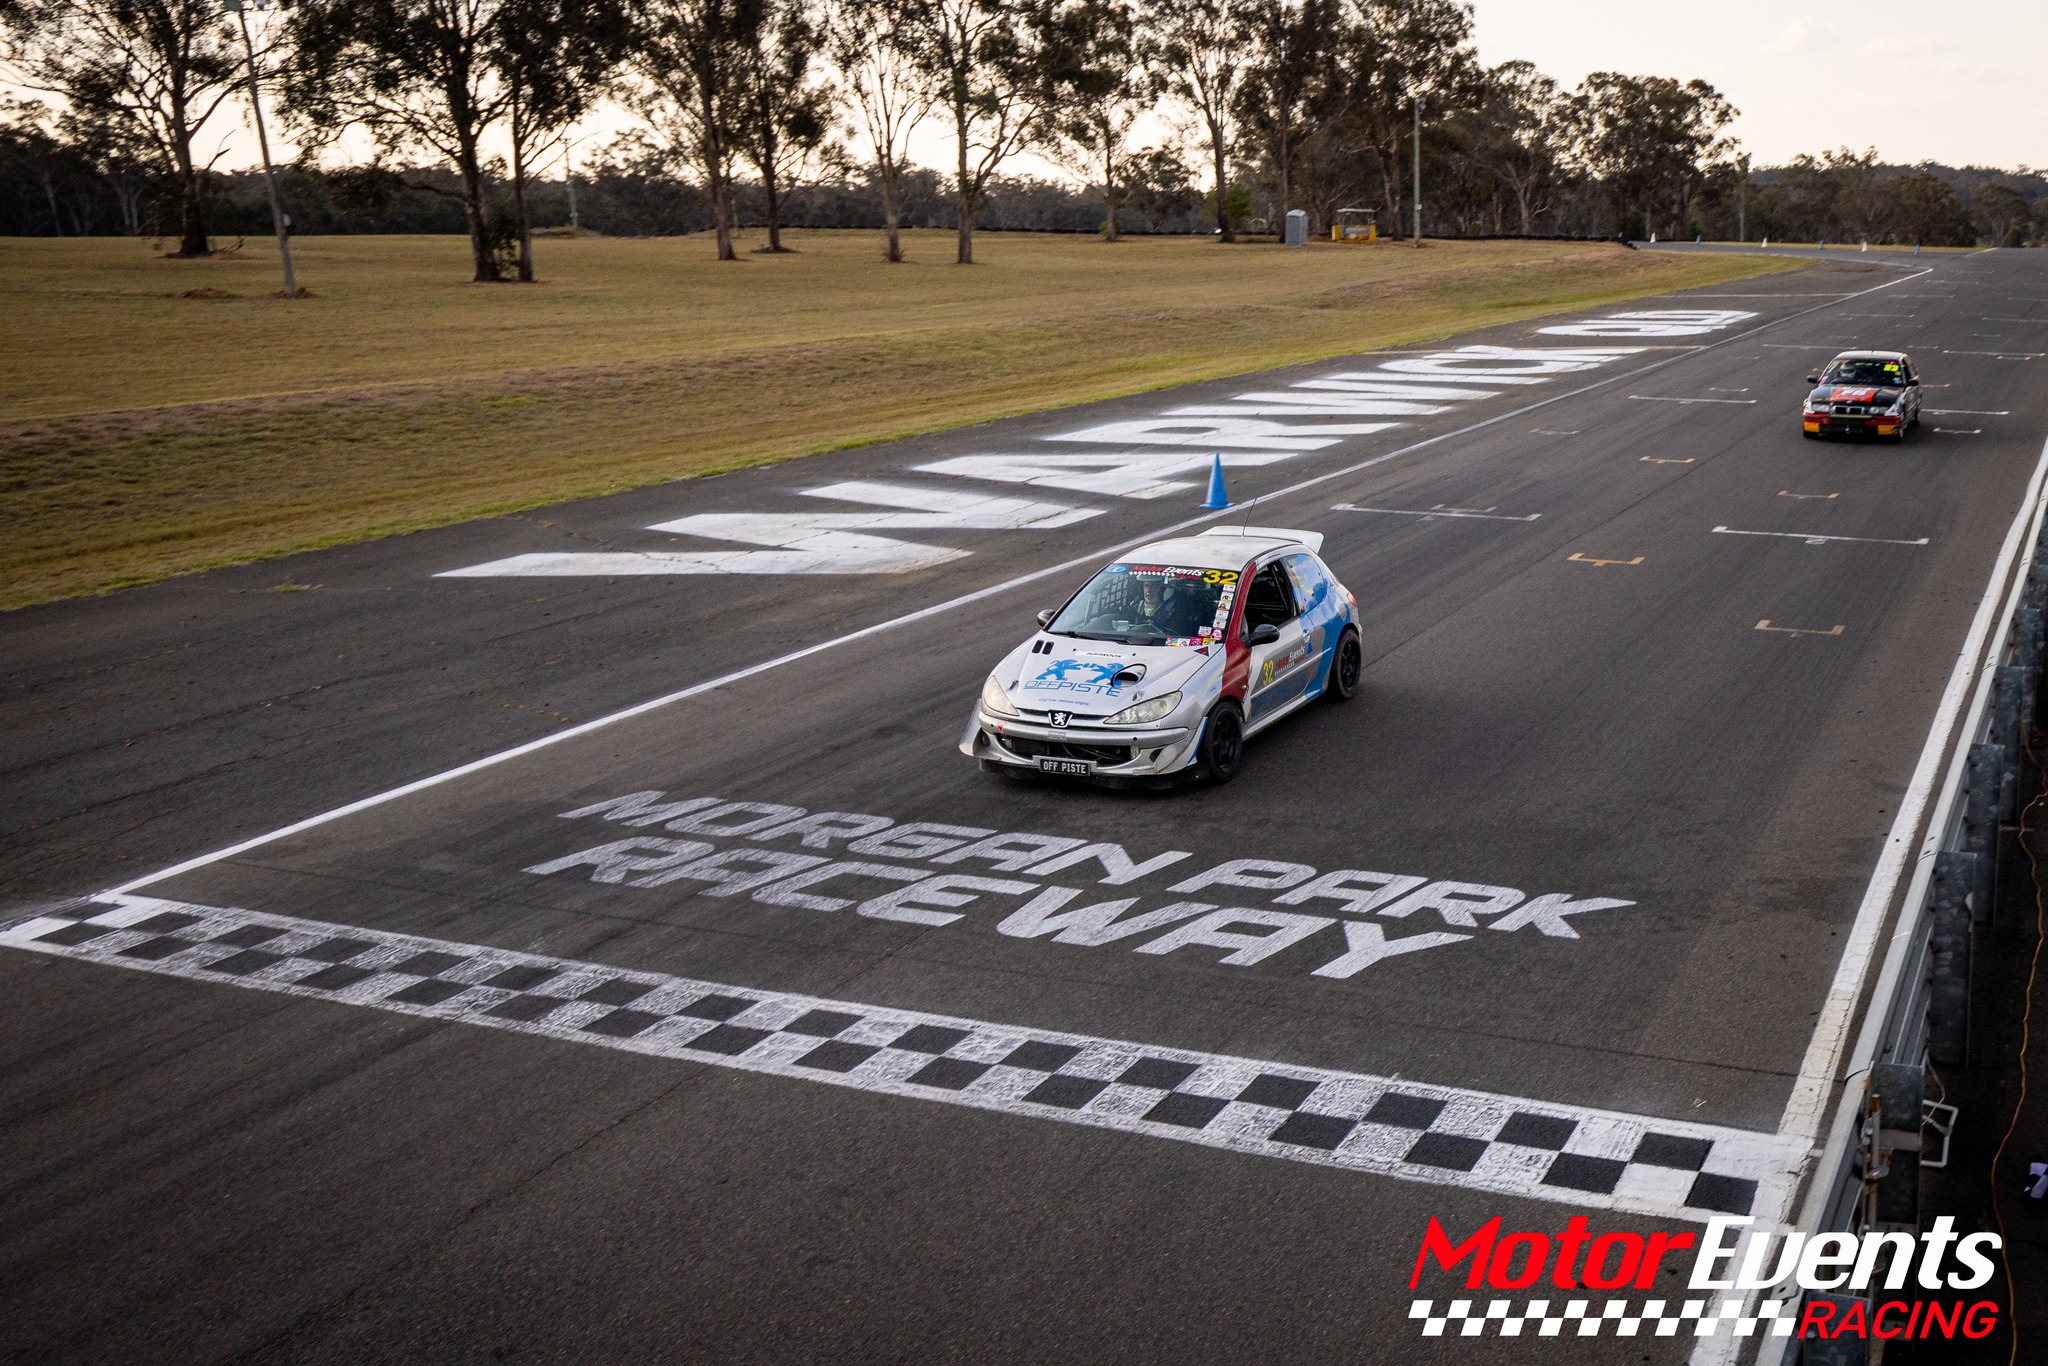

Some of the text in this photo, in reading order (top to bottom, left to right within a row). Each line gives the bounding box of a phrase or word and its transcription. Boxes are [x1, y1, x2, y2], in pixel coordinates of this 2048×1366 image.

[1203, 569, 1239, 585] 32
[1263, 659, 1274, 686] 32
[1043, 761, 1086, 774] OFF PISTE
[556, 790, 1638, 940] MORGAN PARK
[520, 836, 1475, 980] RACEWAY
